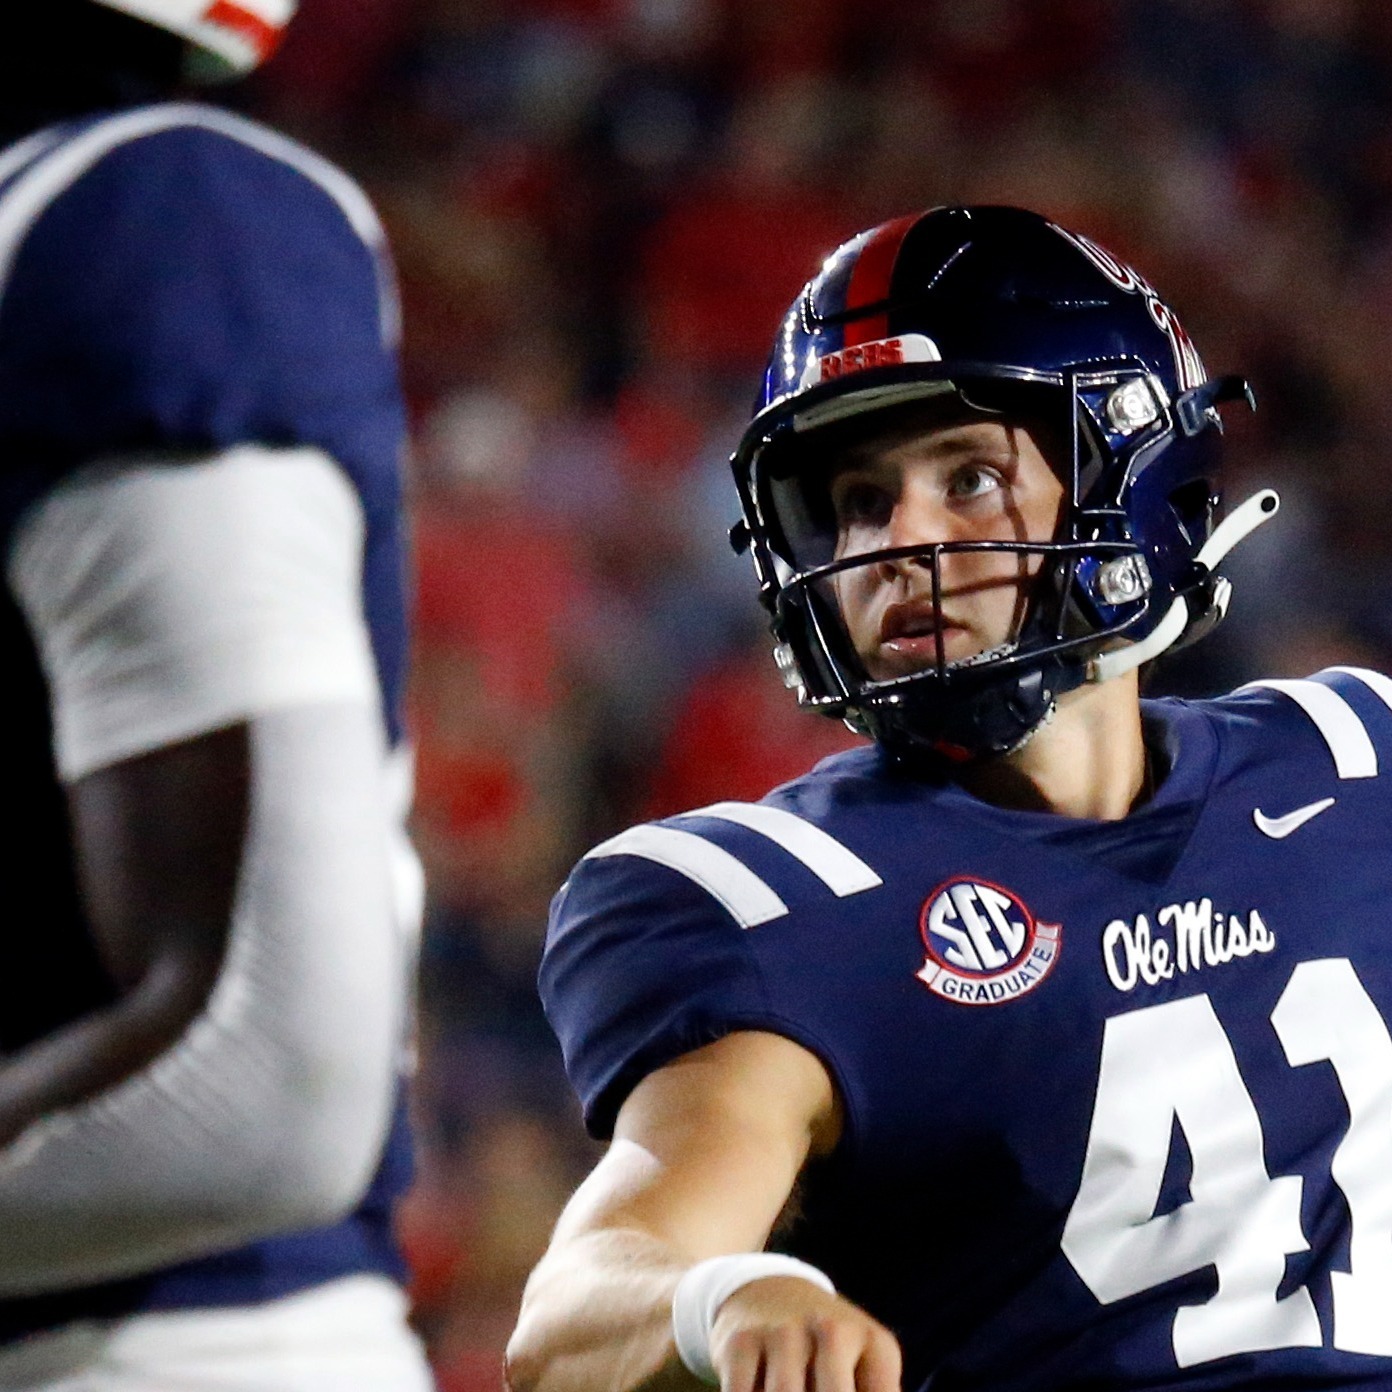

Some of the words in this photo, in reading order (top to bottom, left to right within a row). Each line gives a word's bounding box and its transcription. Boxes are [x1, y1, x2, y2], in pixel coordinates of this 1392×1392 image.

[928, 884, 1026, 970] SEC
[1102, 913, 1175, 991] Ole
[1157, 897, 1276, 966] Miss
[942, 946, 1052, 1001] GRADUATE
